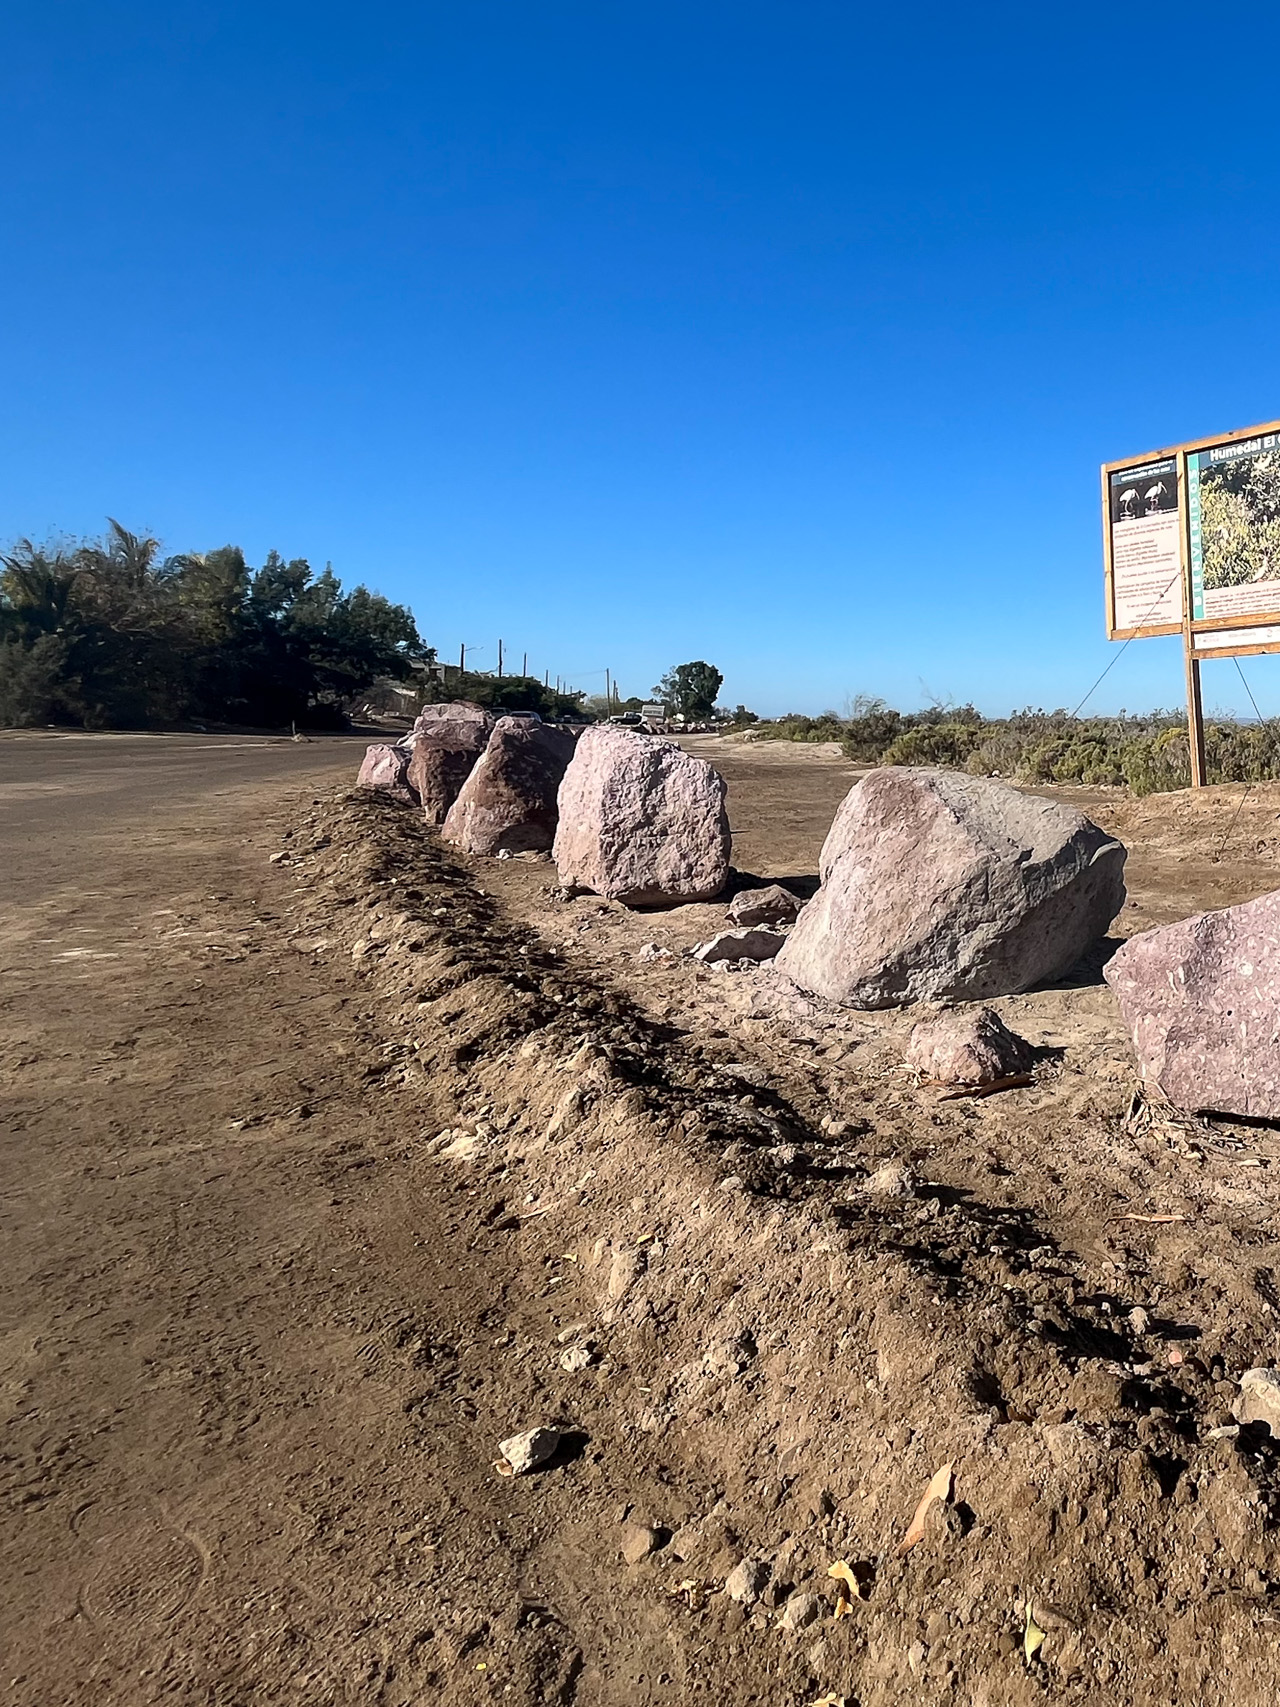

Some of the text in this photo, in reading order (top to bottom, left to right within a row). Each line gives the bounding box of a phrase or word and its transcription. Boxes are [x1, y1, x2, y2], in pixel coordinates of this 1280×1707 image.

[1209, 438, 1261, 461] Humedal
[1263, 434, 1276, 449] El
[1189, 469, 1203, 606] BIENVENIDOS
